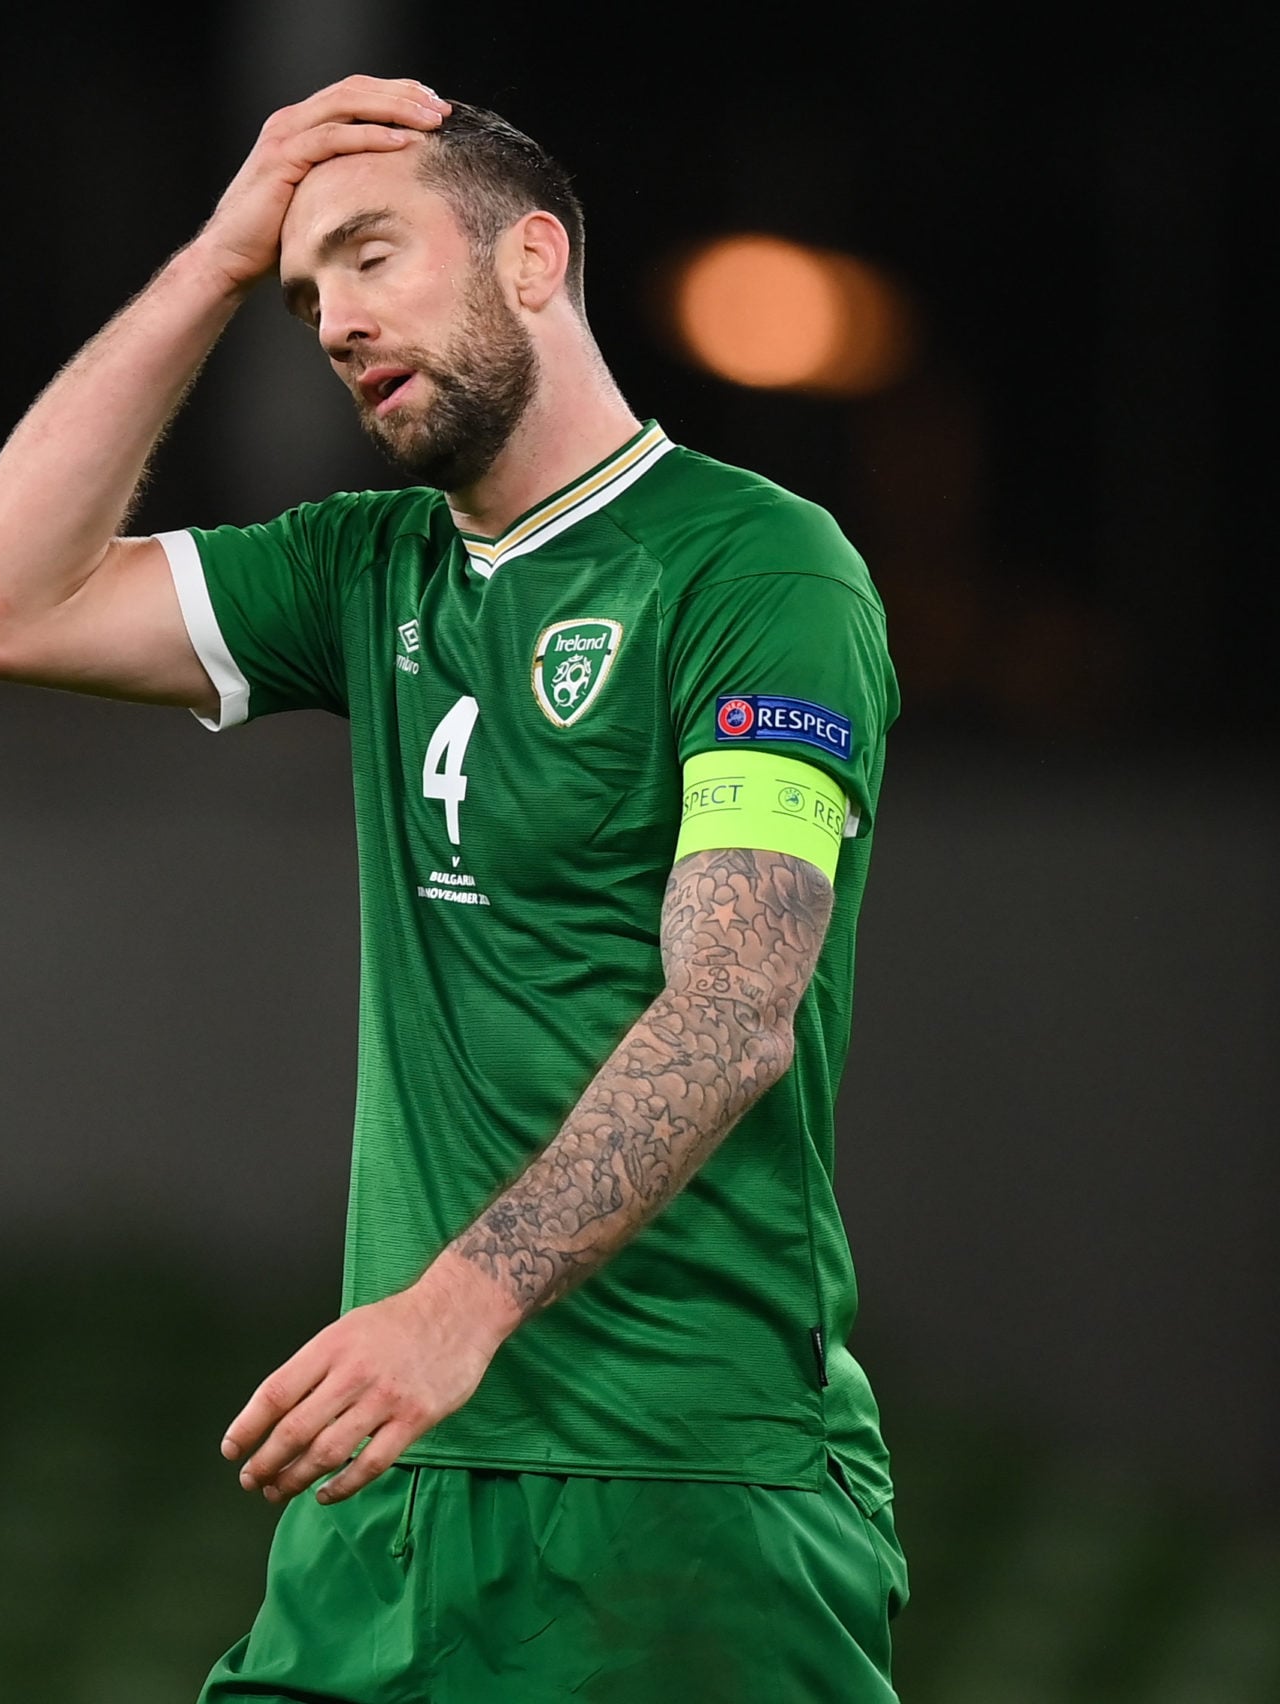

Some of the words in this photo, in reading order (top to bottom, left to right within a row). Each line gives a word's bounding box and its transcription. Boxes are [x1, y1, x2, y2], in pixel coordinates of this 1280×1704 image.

[555, 633, 608, 652] Ireland
[396, 654, 419, 675] mbro
[758, 708, 850, 747] RESPECT
[423, 695, 479, 845] 4
[814, 799, 844, 836] RES
[429, 871, 476, 886] BULGARIA
[426, 887, 478, 904] NOVEMBER
